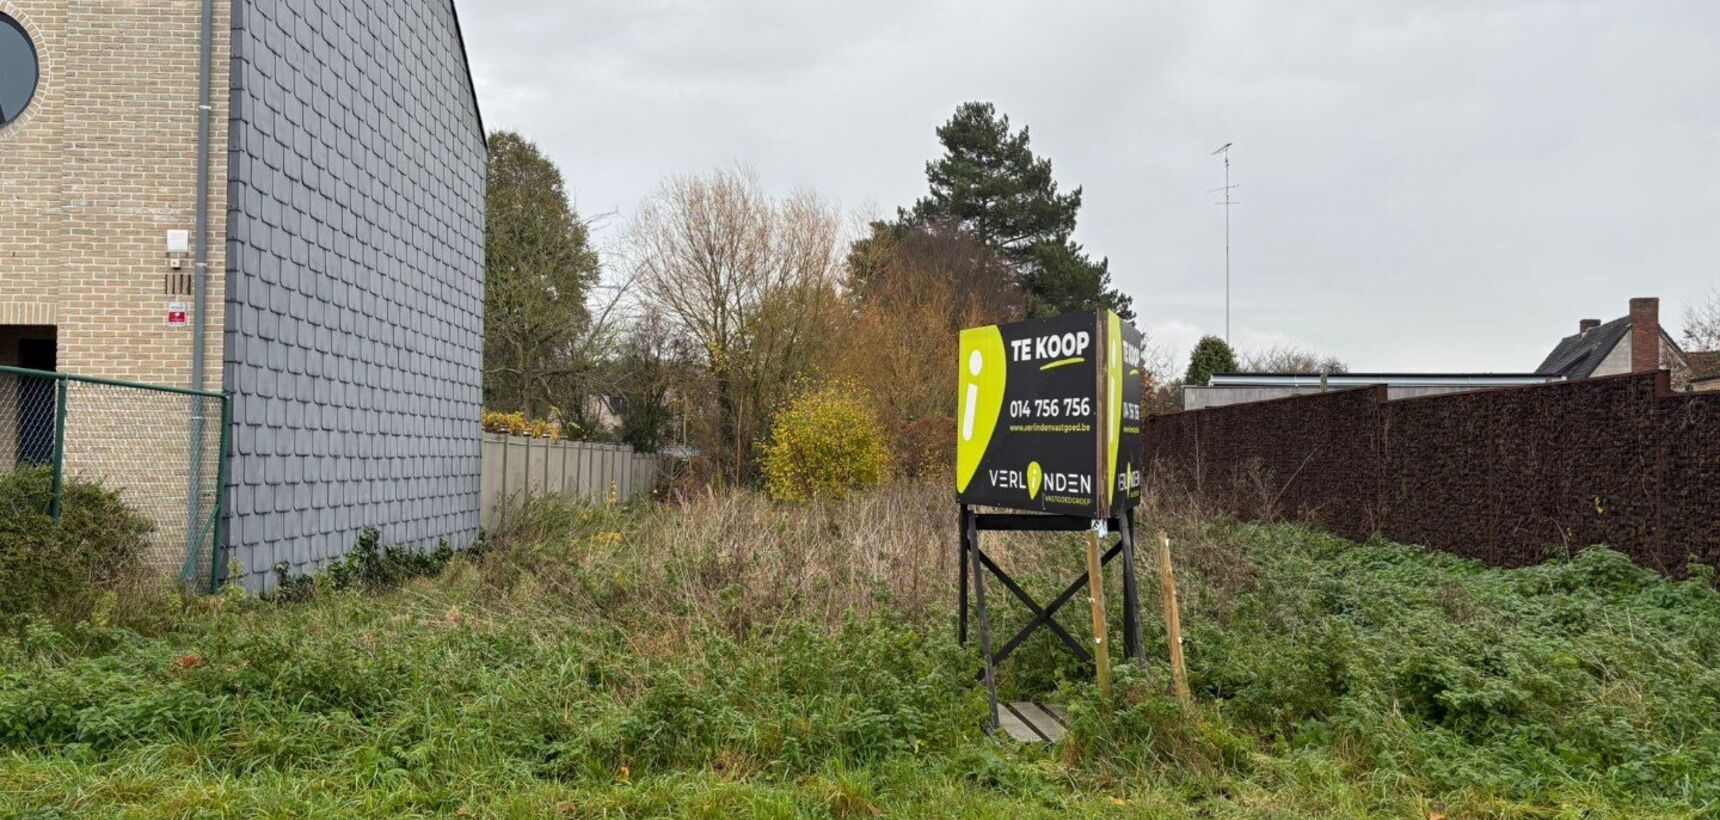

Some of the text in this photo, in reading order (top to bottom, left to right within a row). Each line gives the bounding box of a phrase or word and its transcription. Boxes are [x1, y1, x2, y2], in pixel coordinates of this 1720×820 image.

[1011, 331, 1090, 361] TE KOOP
[1009, 397, 1090, 418] 014 756 756
[1009, 422, 1091, 433] www.verlindenvastgoed.be
